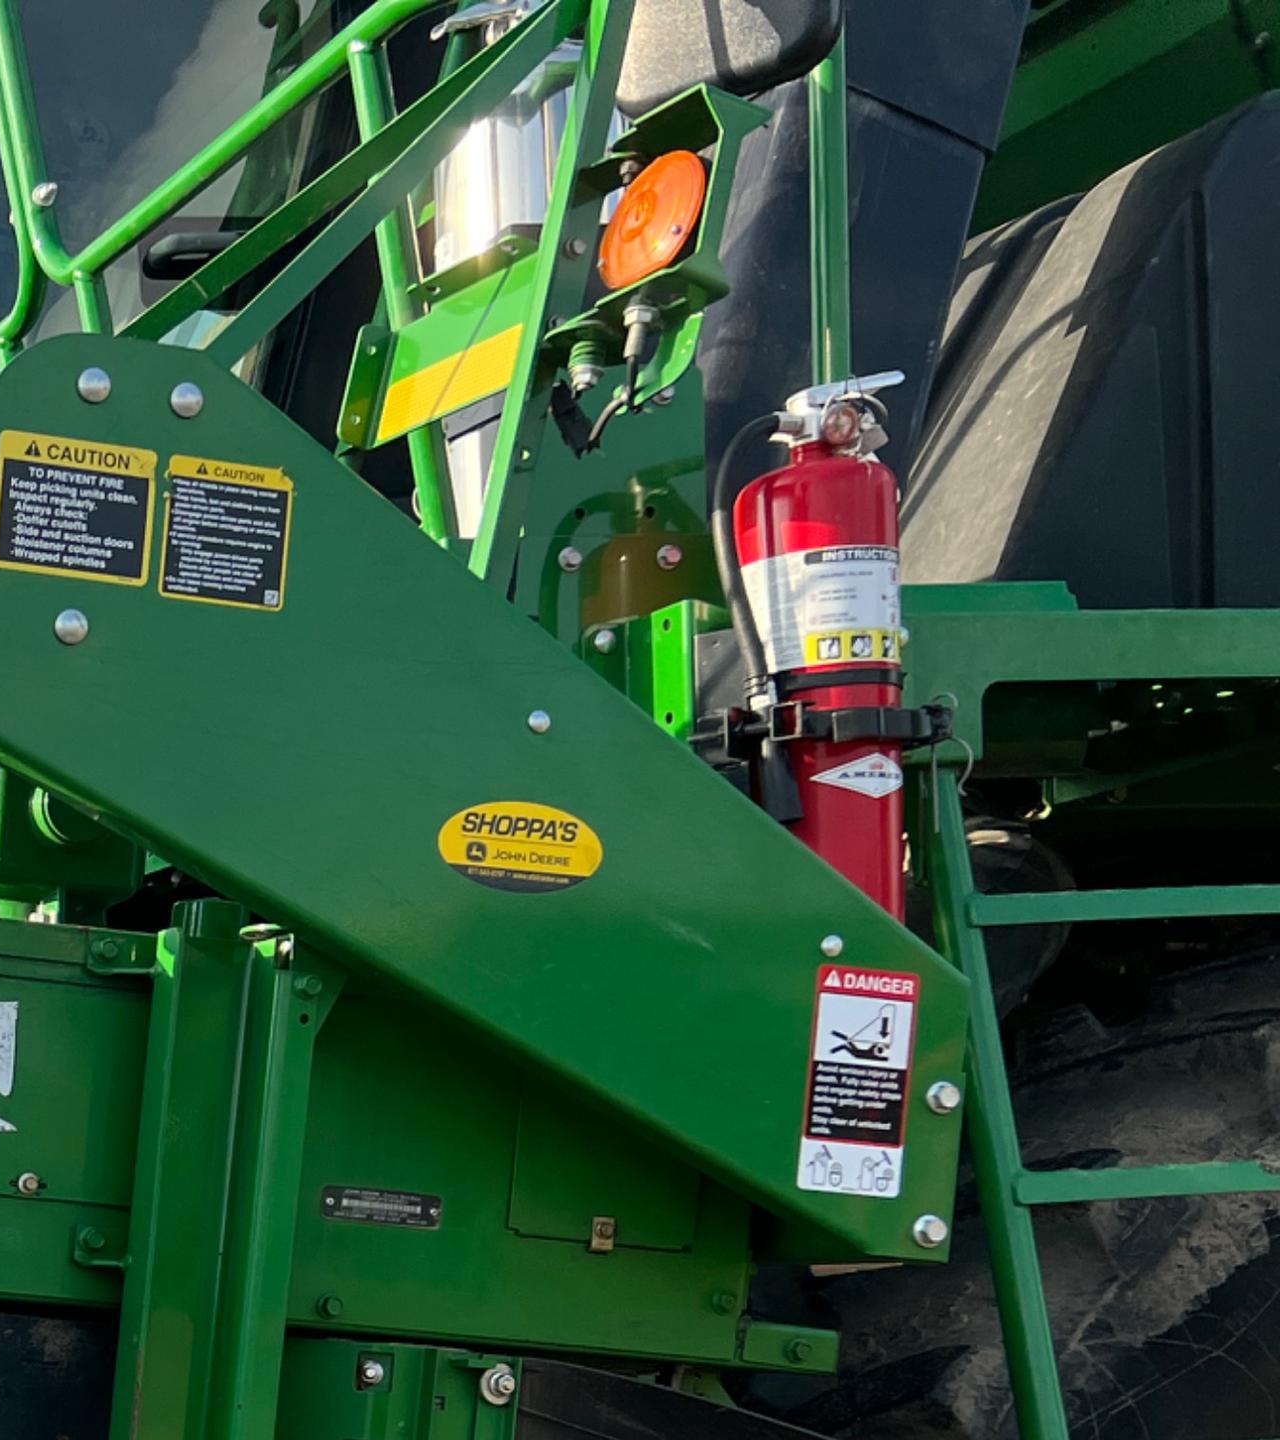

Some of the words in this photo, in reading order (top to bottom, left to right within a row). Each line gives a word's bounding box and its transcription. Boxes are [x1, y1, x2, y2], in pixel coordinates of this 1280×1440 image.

[47, 443, 131, 470] CAUTION
[28, 466, 44, 479] TO
[46, 469, 97, 486] PREVENT
[98, 477, 125, 490] FIRE
[214, 467, 265, 483] CAUTION
[9, 489, 49, 505] Inspect
[10, 477, 37, 492] Keep
[40, 481, 78, 498] picking
[80, 486, 105, 500] units
[14, 502, 52, 517] Always
[41, 529, 62, 540] and
[63, 532, 102, 546] suction
[103, 536, 134, 550] doors
[62, 555, 106, 569] spindles
[68, 545, 113, 559] columns
[461, 811, 578, 842] SHOPPA'S
[492, 848, 527, 862] JOHN
[530, 851, 571, 867] DEERE
[843, 972, 915, 996] DANGER
